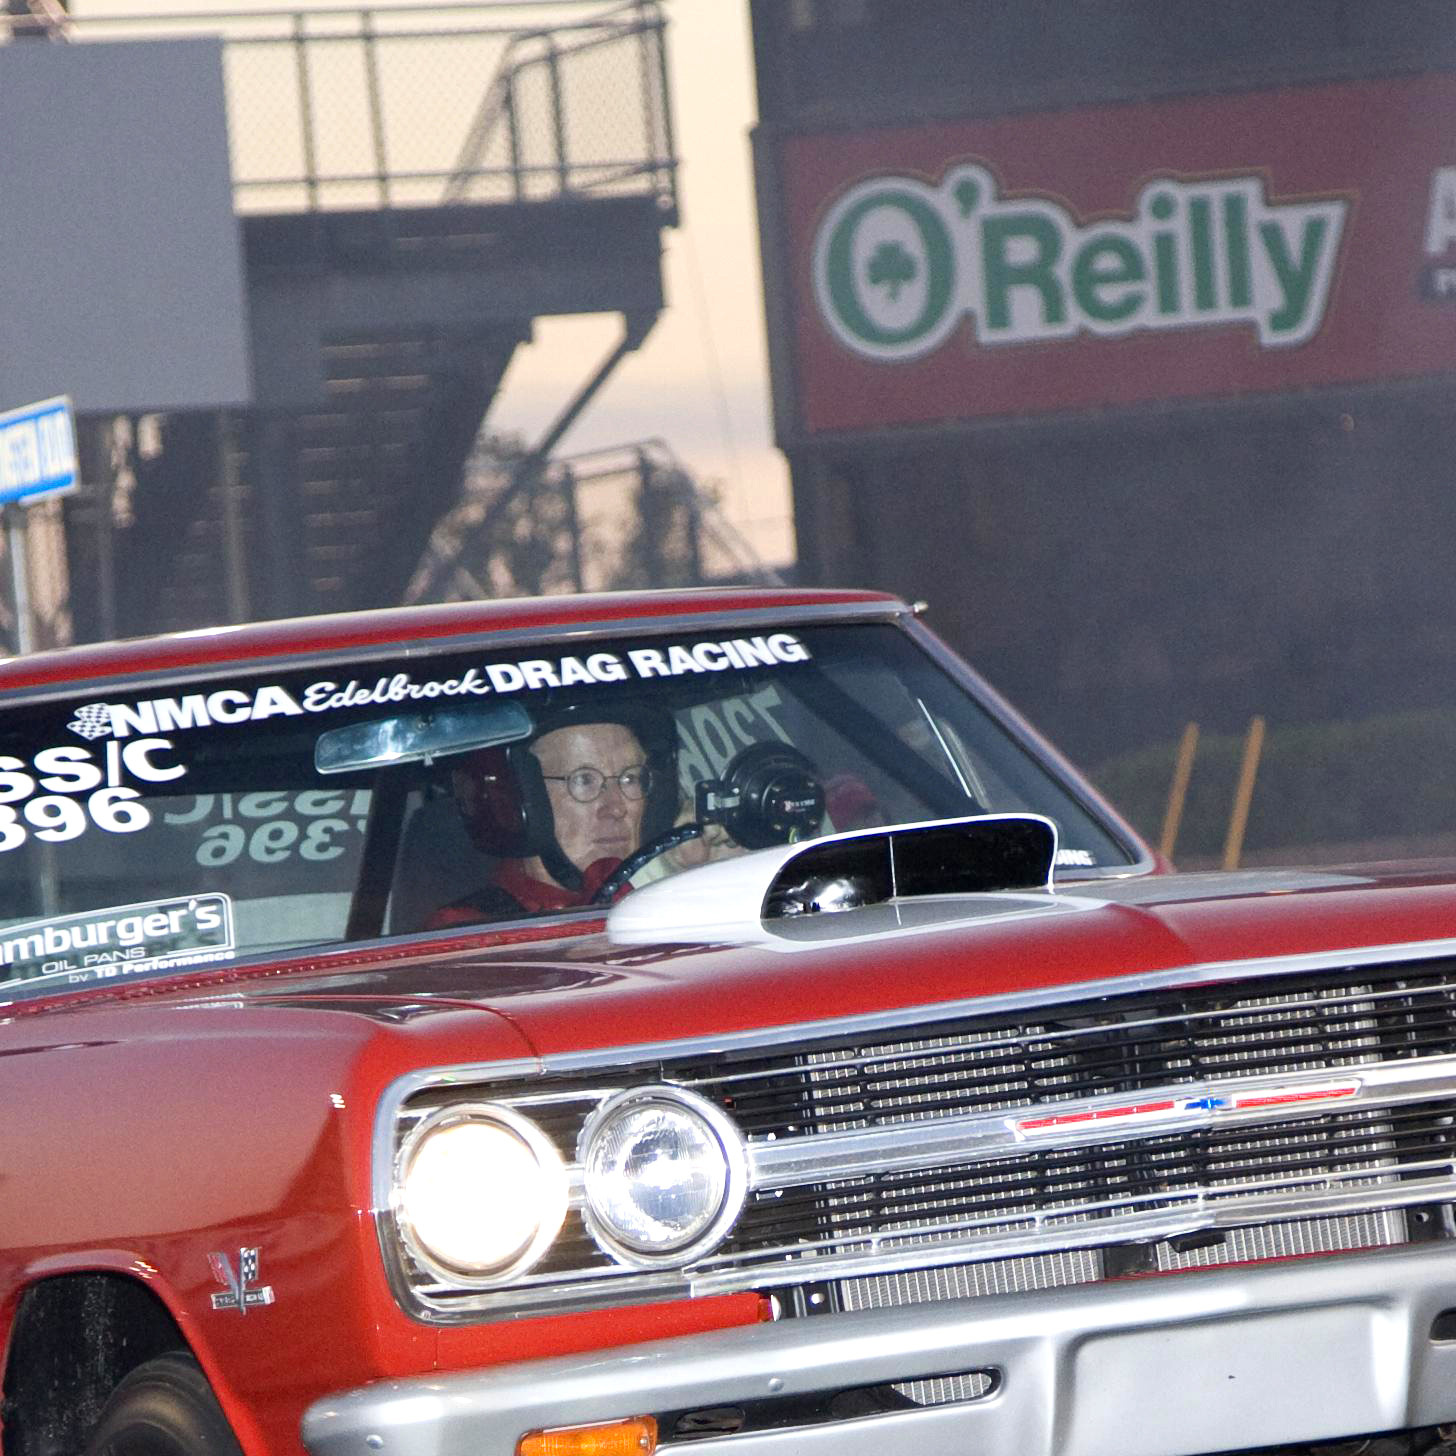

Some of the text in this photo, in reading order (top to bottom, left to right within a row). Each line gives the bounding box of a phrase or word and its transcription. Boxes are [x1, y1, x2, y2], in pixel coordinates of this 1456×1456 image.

[816, 168, 1344, 354] O'Reilly
[110, 633, 811, 738] NMCA Edelbrock DRAG RACING
[41, 946, 147, 976] OIL PANS
[68, 950, 236, 984] by TD Performance
